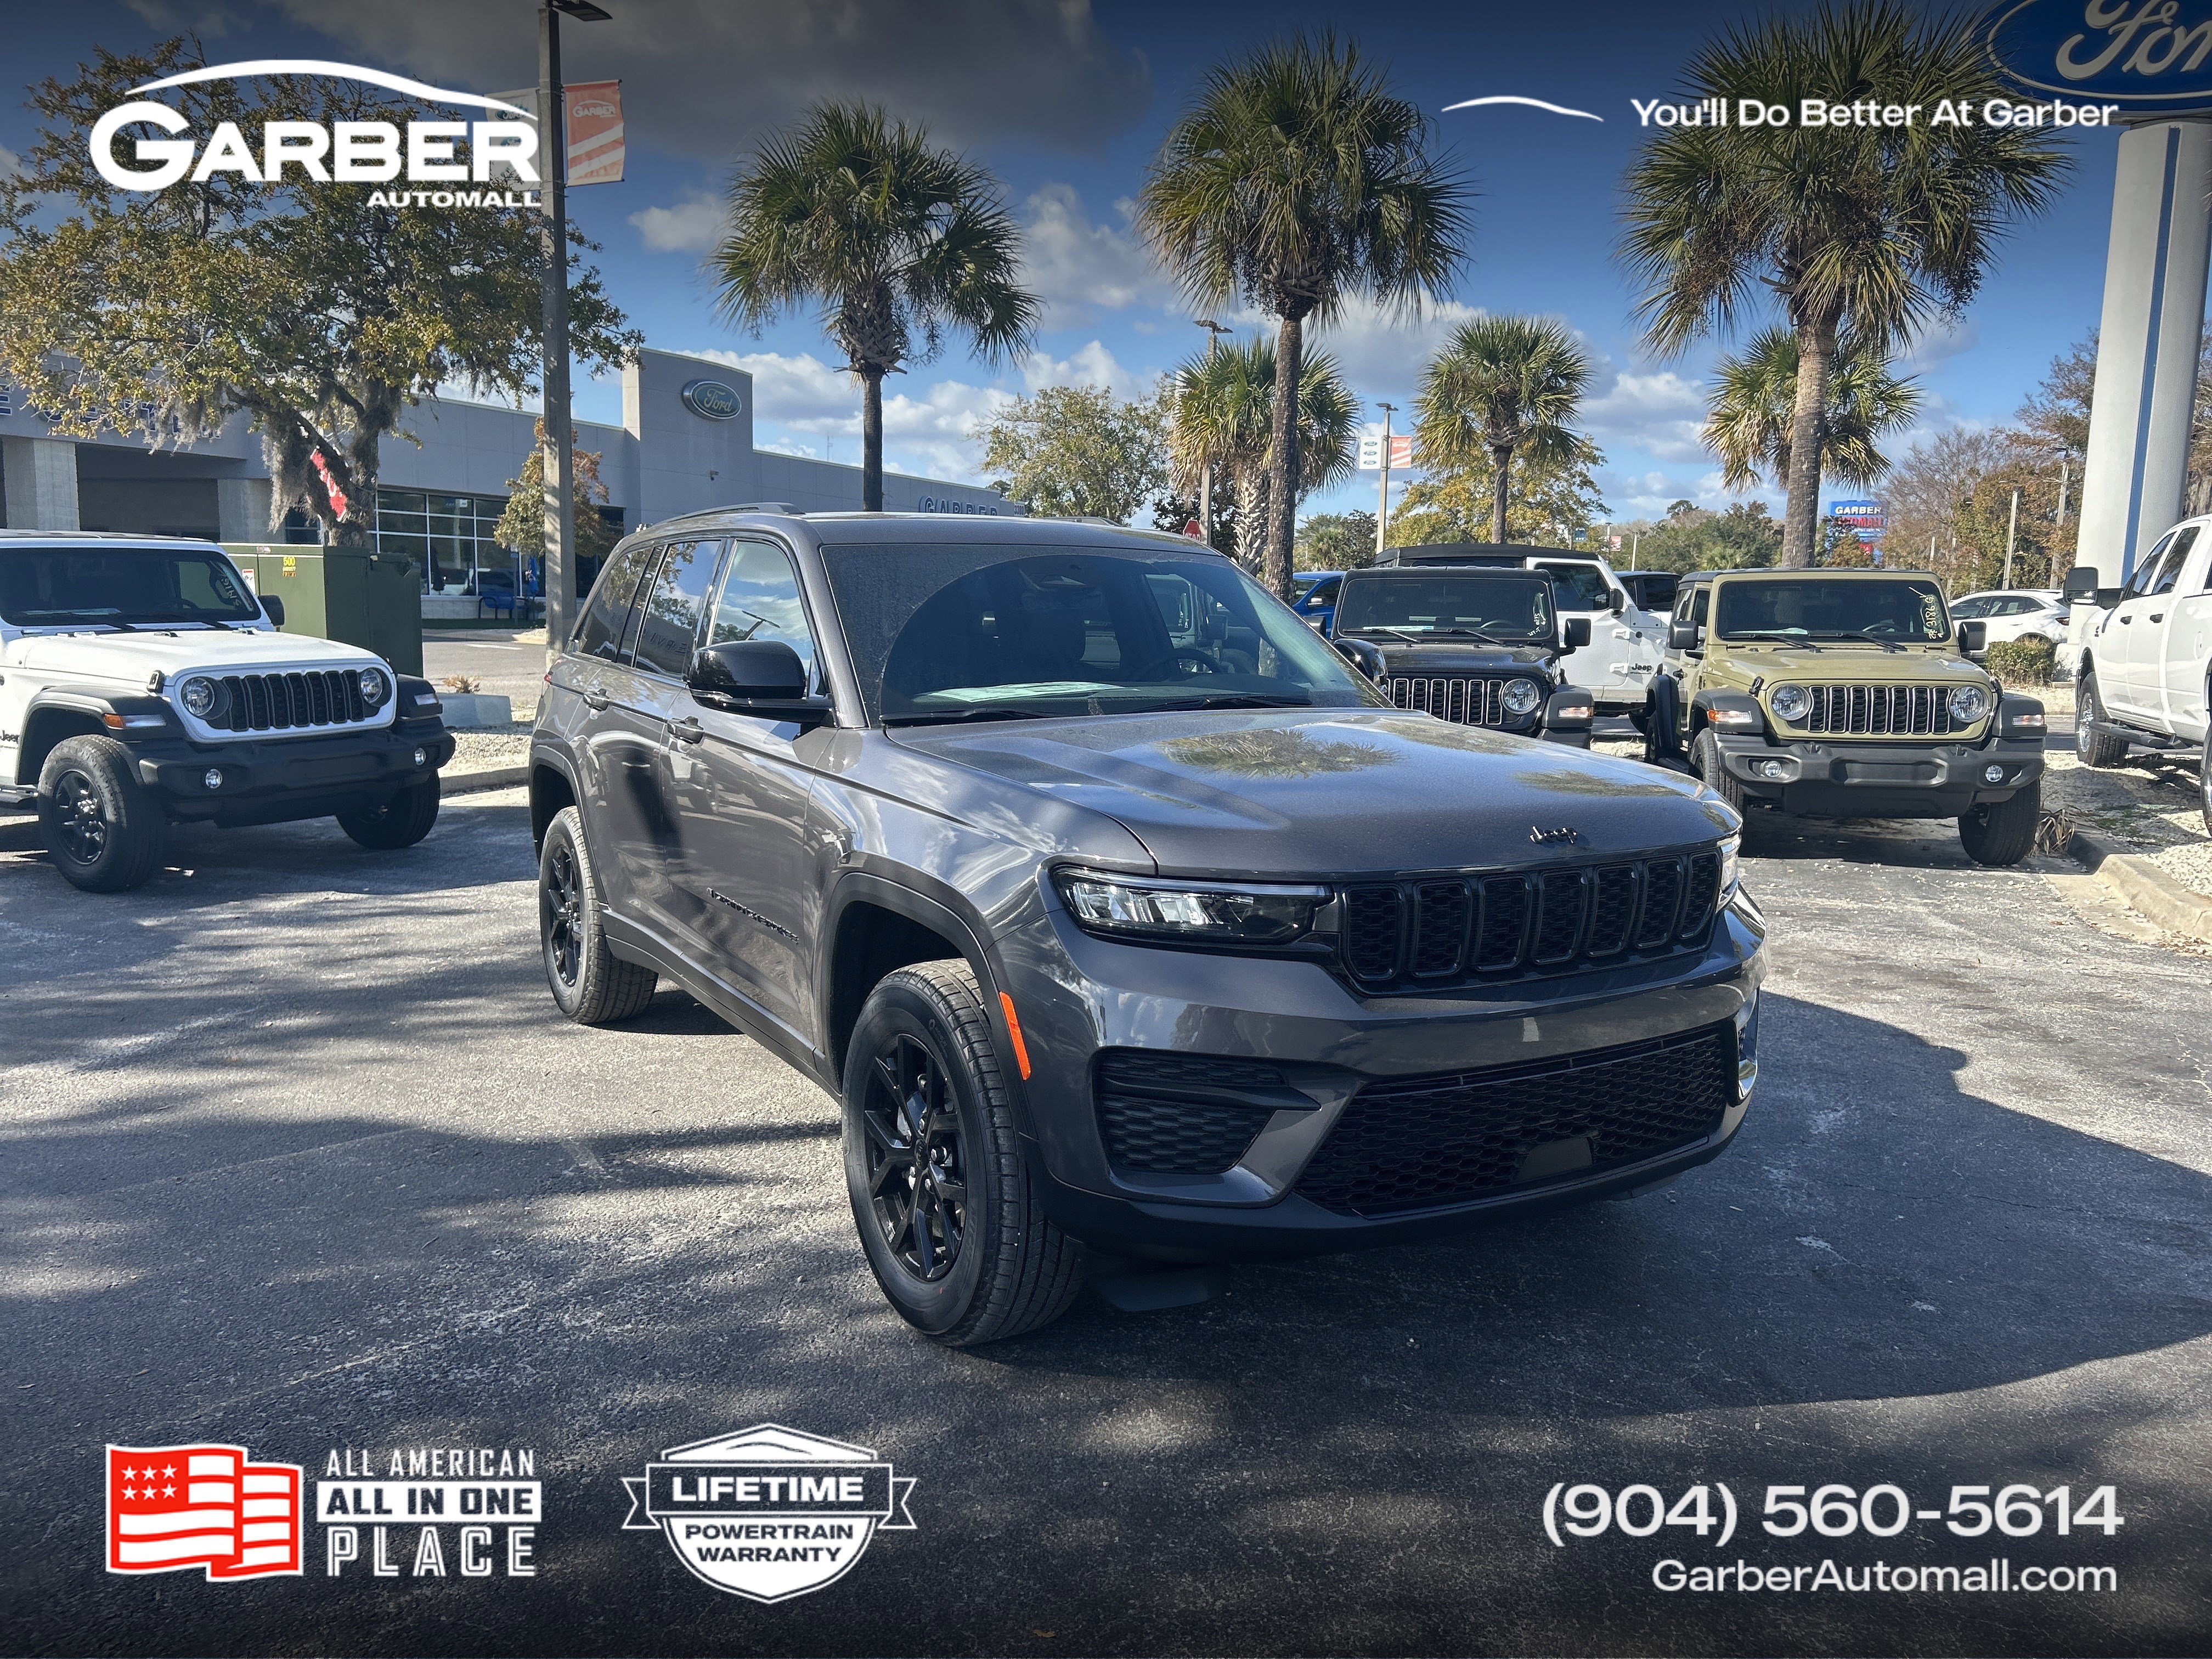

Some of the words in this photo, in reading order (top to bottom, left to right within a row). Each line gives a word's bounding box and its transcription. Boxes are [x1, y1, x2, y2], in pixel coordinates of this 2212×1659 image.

[2056, 0, 2212, 81] For
[573, 105, 615, 117] GARBER
[704, 388, 733, 413] Ford
[1835, 506, 1882, 515] GARBER
[1632, 663, 1652, 672] Jeep
[1530, 825, 1578, 844] Jeep
